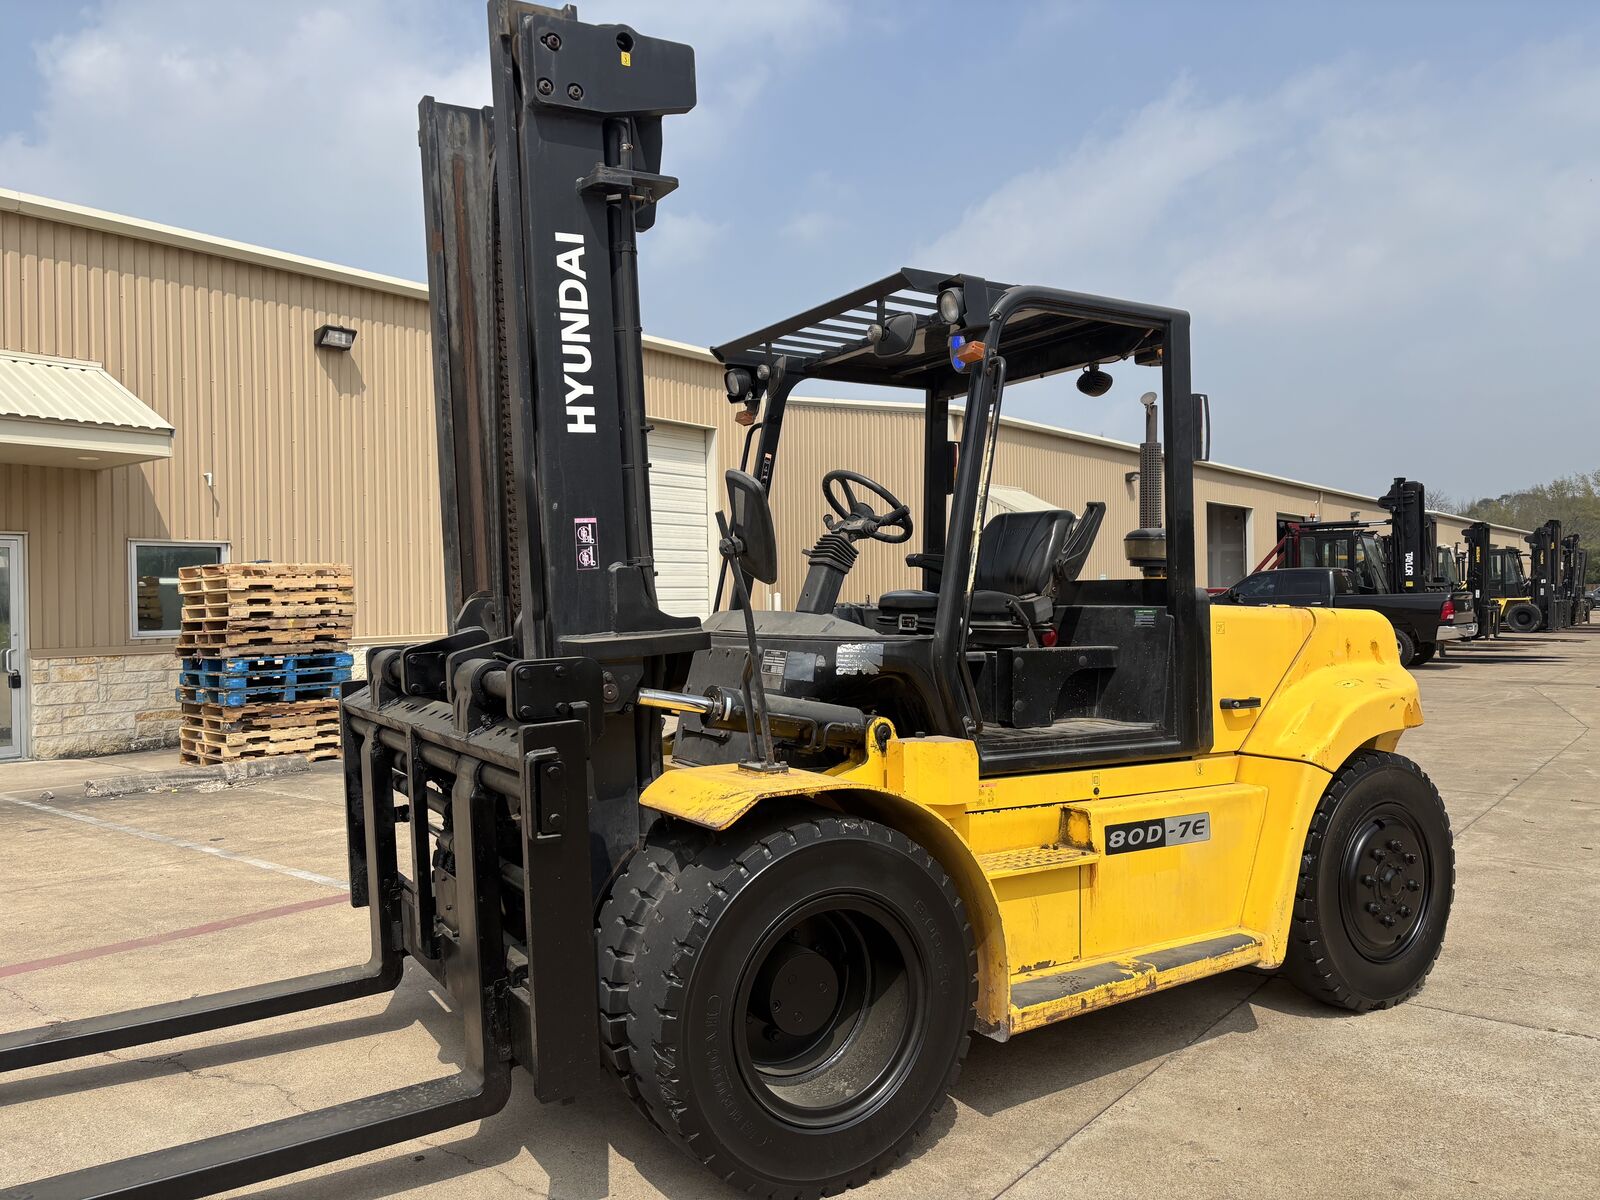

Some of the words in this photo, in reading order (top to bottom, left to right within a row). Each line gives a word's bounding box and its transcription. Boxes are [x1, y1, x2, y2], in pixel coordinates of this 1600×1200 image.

[555, 231, 597, 434] HYUNDAI
[1405, 551, 1414, 576] TAYLOR
[1108, 818, 1206, 848] 80D-7E
